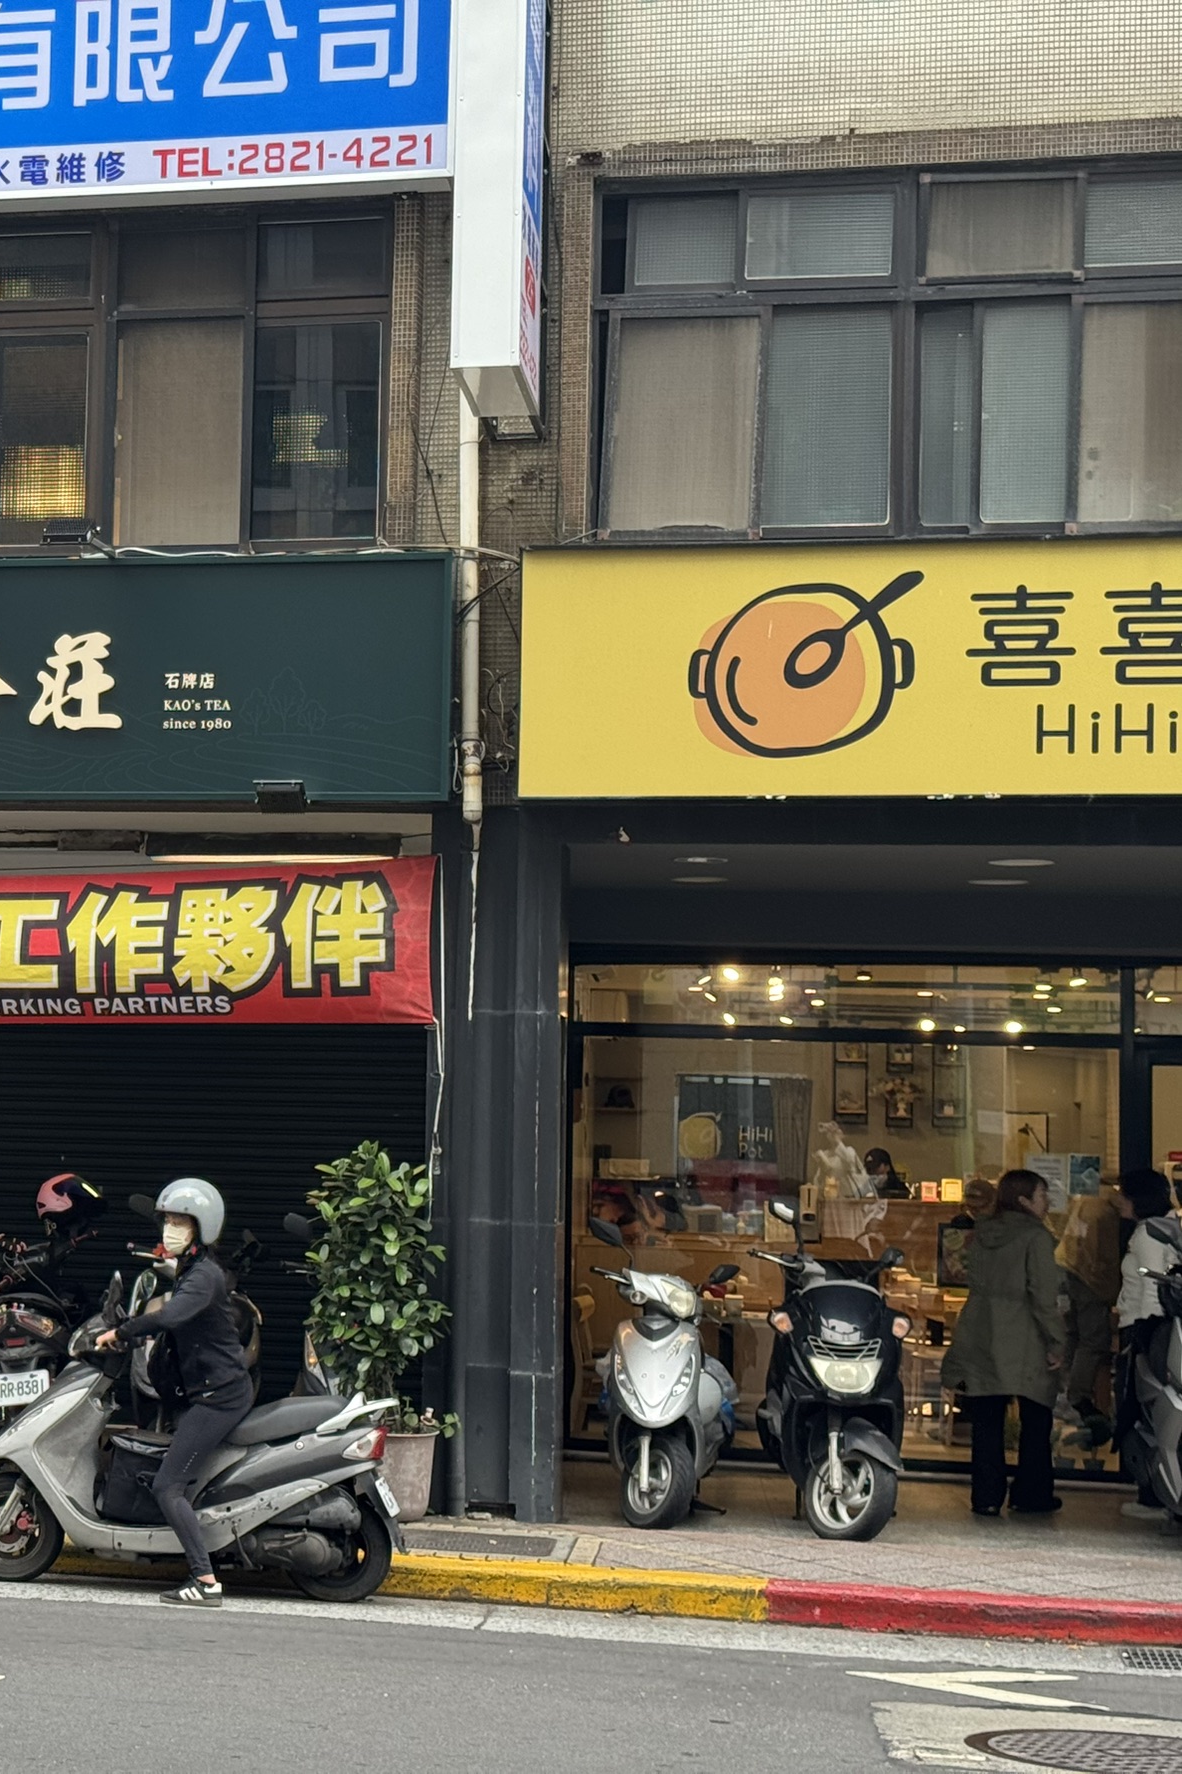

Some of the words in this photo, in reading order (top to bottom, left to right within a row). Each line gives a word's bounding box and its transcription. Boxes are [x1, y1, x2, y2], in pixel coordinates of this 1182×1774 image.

[152, 133, 434, 179] TEL:2821-4221
[965, 581, 1182, 687] 喜喜
[164, 672, 215, 690] 石牌店
[163, 699, 201, 711] KAO's
[204, 699, 232, 711] TEA
[162, 717, 197, 729] since
[200, 717, 232, 732] 1980
[1035, 702, 1179, 755] HiHi
[93, 995, 232, 1015] PARTNERS
[738, 1125, 773, 1142] HiHi
[738, 1142, 763, 1159] Pot
